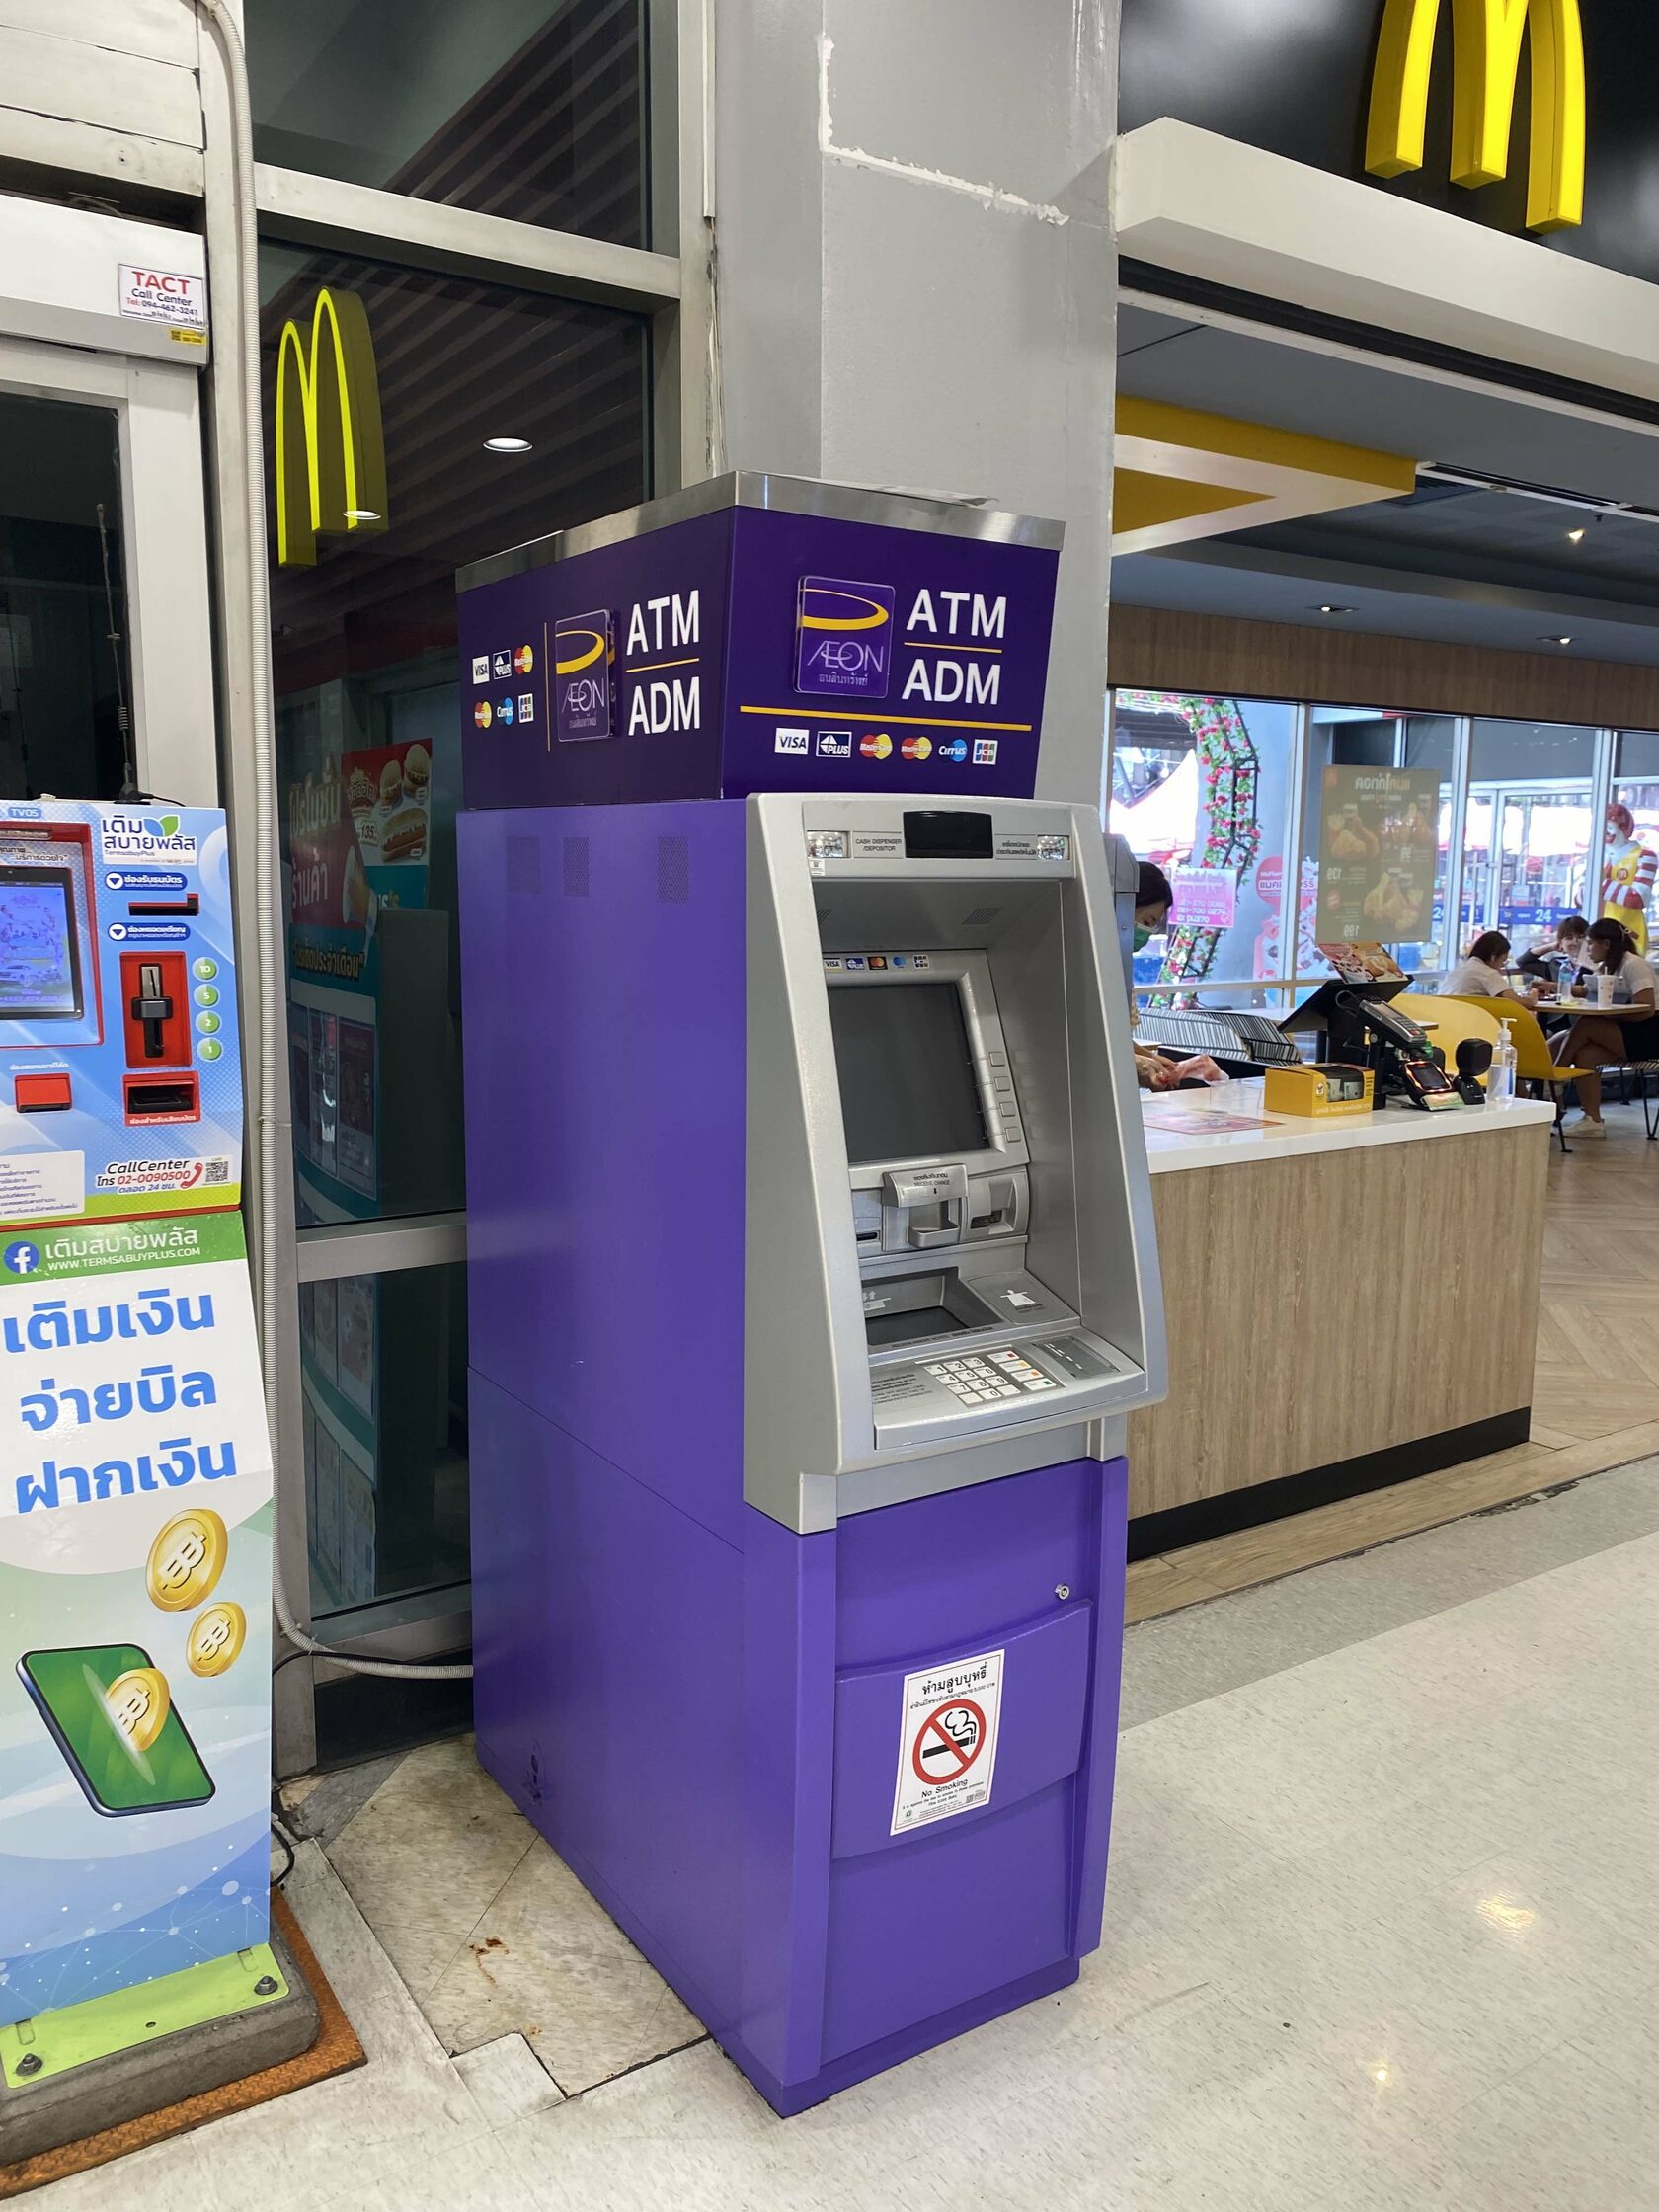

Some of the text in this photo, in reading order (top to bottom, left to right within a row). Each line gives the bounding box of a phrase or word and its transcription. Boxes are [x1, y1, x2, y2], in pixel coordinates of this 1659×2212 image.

[131, 271, 191, 295] TACT
[131, 287, 193, 307] Call Center
[626, 589, 700, 657] ATM
[906, 589, 1007, 639] ATM
[474, 663, 488, 677] VISA
[902, 658, 1001, 706] ADM
[628, 676, 701, 737] ADM
[779, 736, 807, 750] VISA
[827, 744, 849, 755] PLUS
[938, 745, 967, 756] Cirrus
[975, 748, 995, 756] JCB
[102, 814, 143, 834] เติม
[104, 834, 196, 851] สบายพลัส
[1535, 909, 1552, 923] 24
[200, 964, 211, 974] 10
[203, 991, 210, 1000] 5
[205, 1018, 212, 1027] 2
[208, 1045, 213, 1054] 1
[107, 1159, 190, 1175] CallCenter
[118, 1170, 191, 1185] 02-0090500
[45, 1226, 198, 1260] เติมสบายพลัส
[47, 1246, 201, 1271] WWW.TERMSABUYPLUS.COM
[3, 1288, 215, 1354] เติมเงิน
[20, 1364, 217, 1432] จ่ายบิล
[15, 1436, 237, 1514] ฝากเงิน
[921, 1661, 988, 1695] ห้ามสูบบุหรี่
[921, 1789, 933, 1798] No
[935, 1778, 968, 1794] Smoking
